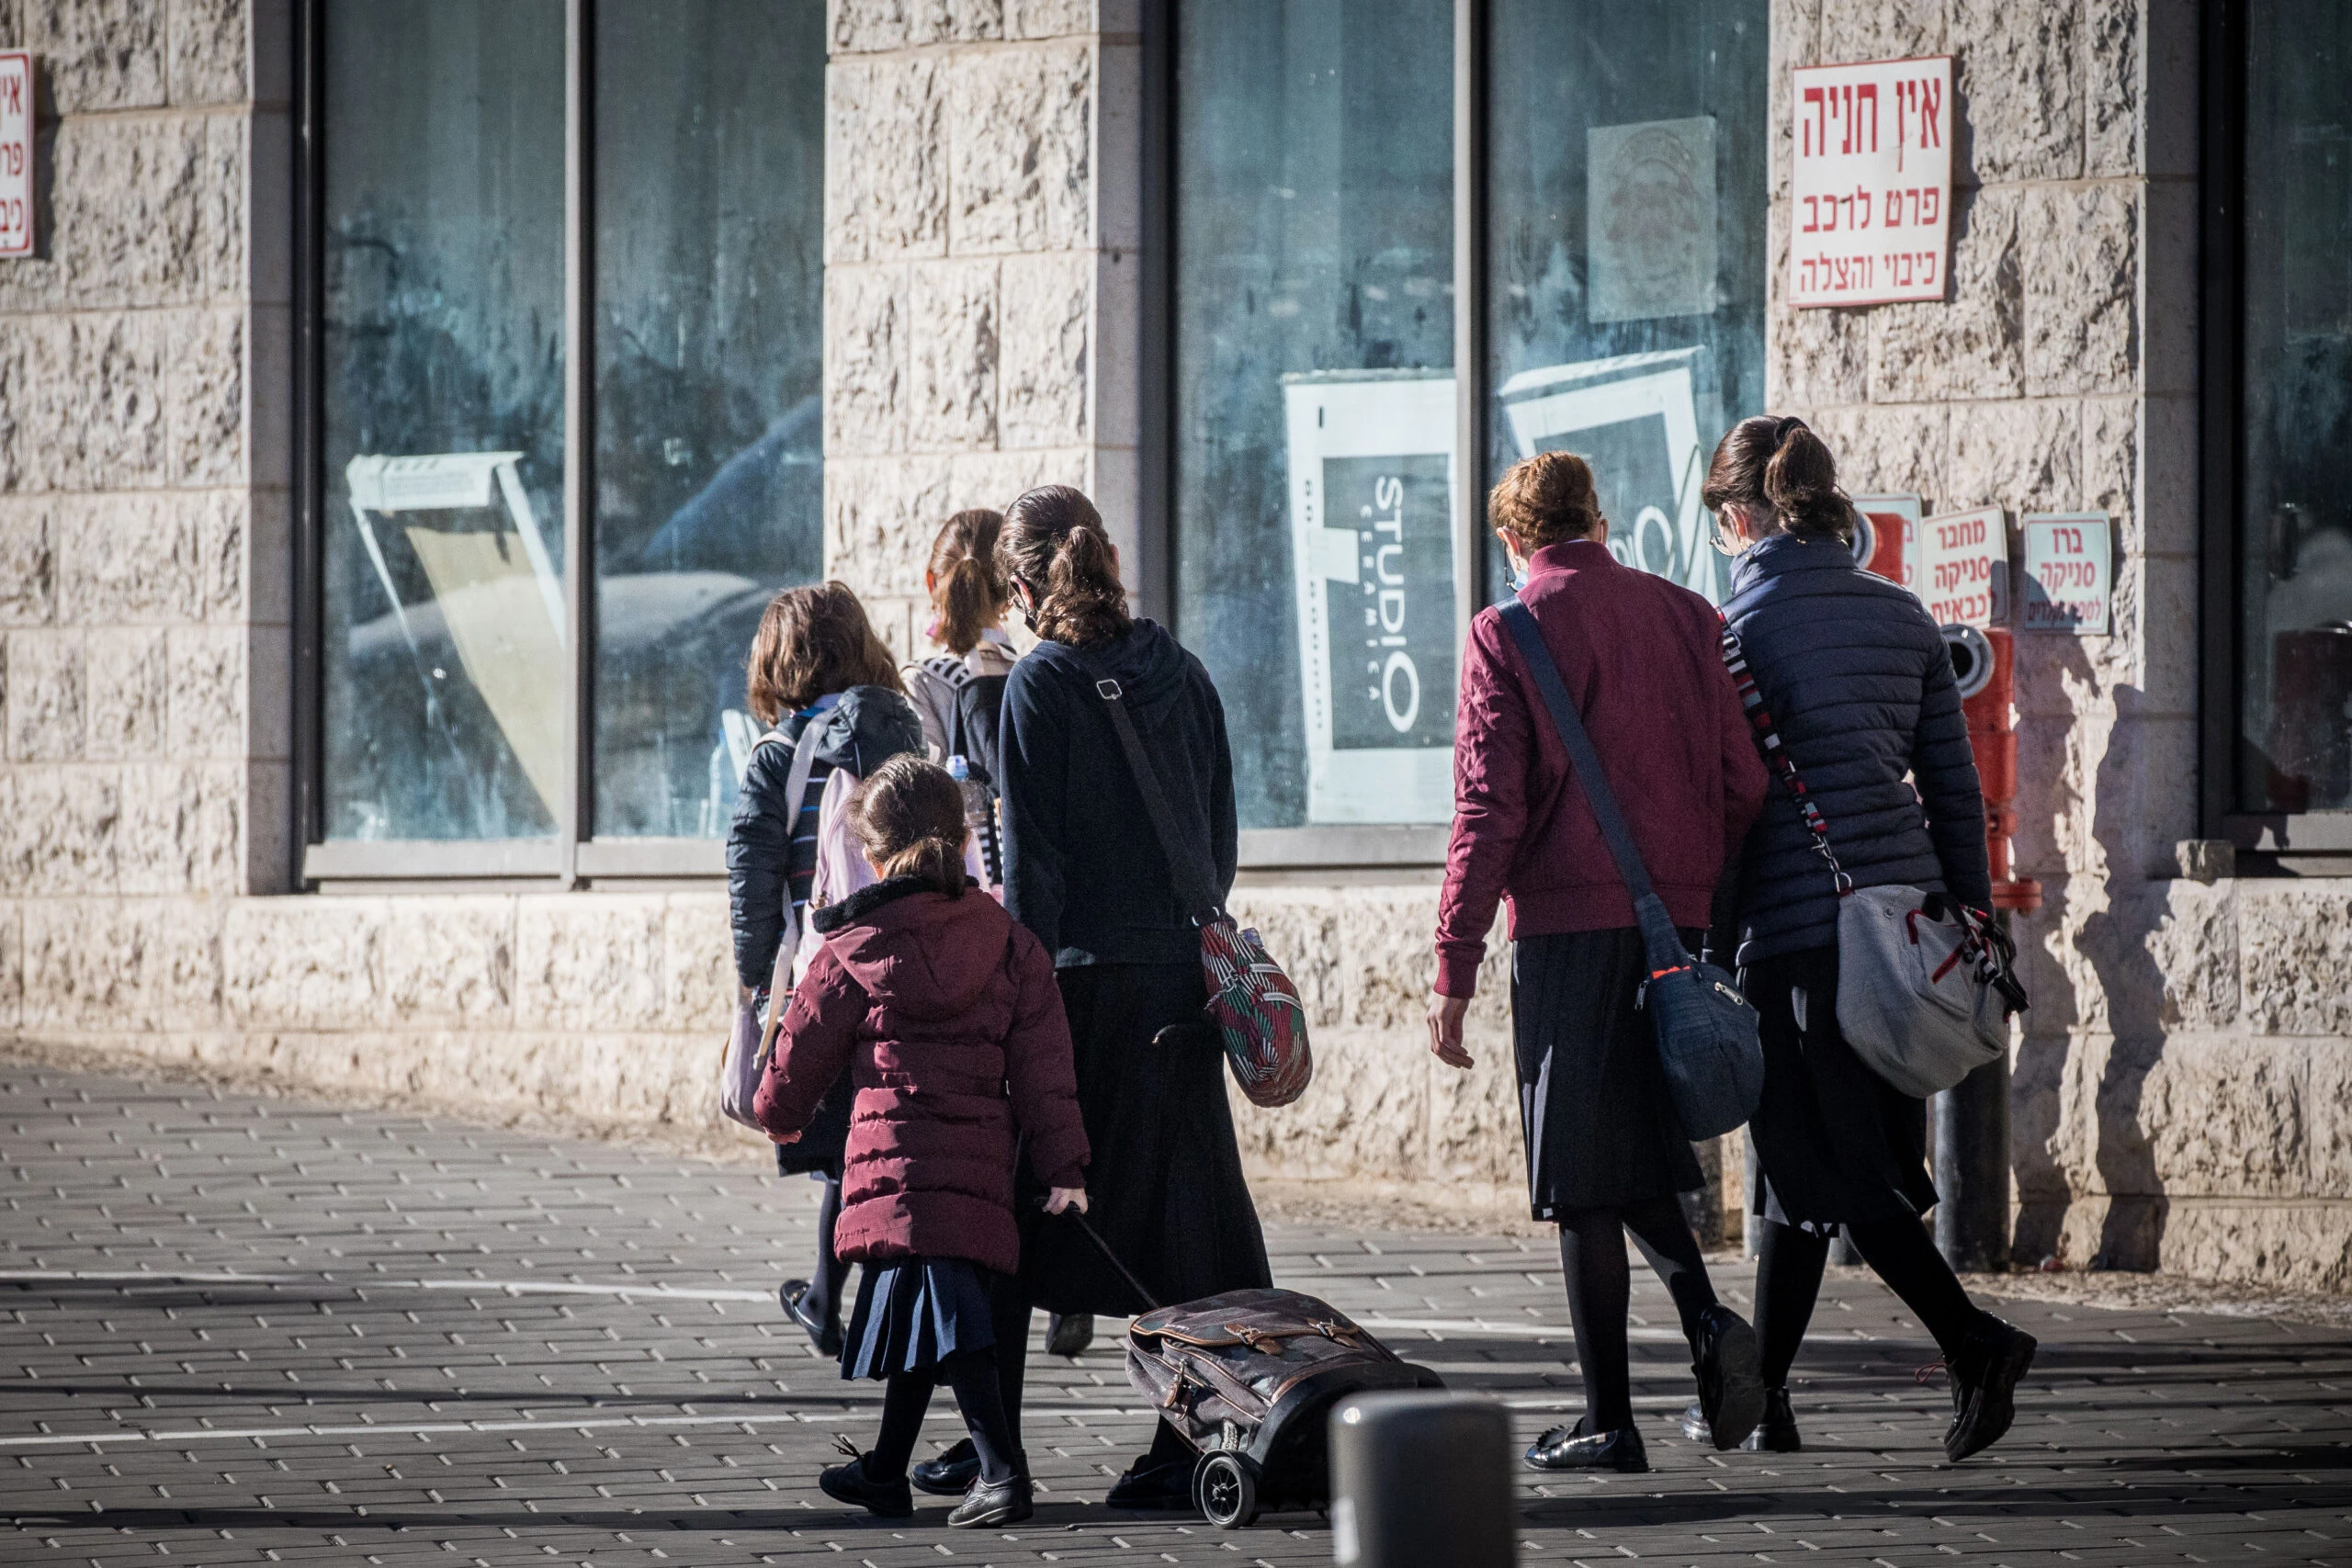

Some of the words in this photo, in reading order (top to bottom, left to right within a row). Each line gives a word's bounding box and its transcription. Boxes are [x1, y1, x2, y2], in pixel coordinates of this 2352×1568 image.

[0, 73, 22, 123] אי
[1804, 83, 1878, 157] חניה
[1896, 77, 1941, 173] אין
[0, 141, 24, 176] פר
[1803, 185, 1871, 233] לרכב
[1884, 186, 1940, 228] פרט
[1801, 251, 1873, 292] והצלה
[1883, 251, 1937, 287] כיבוי
[1937, 518, 1986, 551] מחבר
[2052, 526, 2084, 555] ברז
[1933, 554, 1992, 593] סניקה
[2039, 559, 2097, 595] סניקה
[1374, 475, 1420, 734] STUDIO
